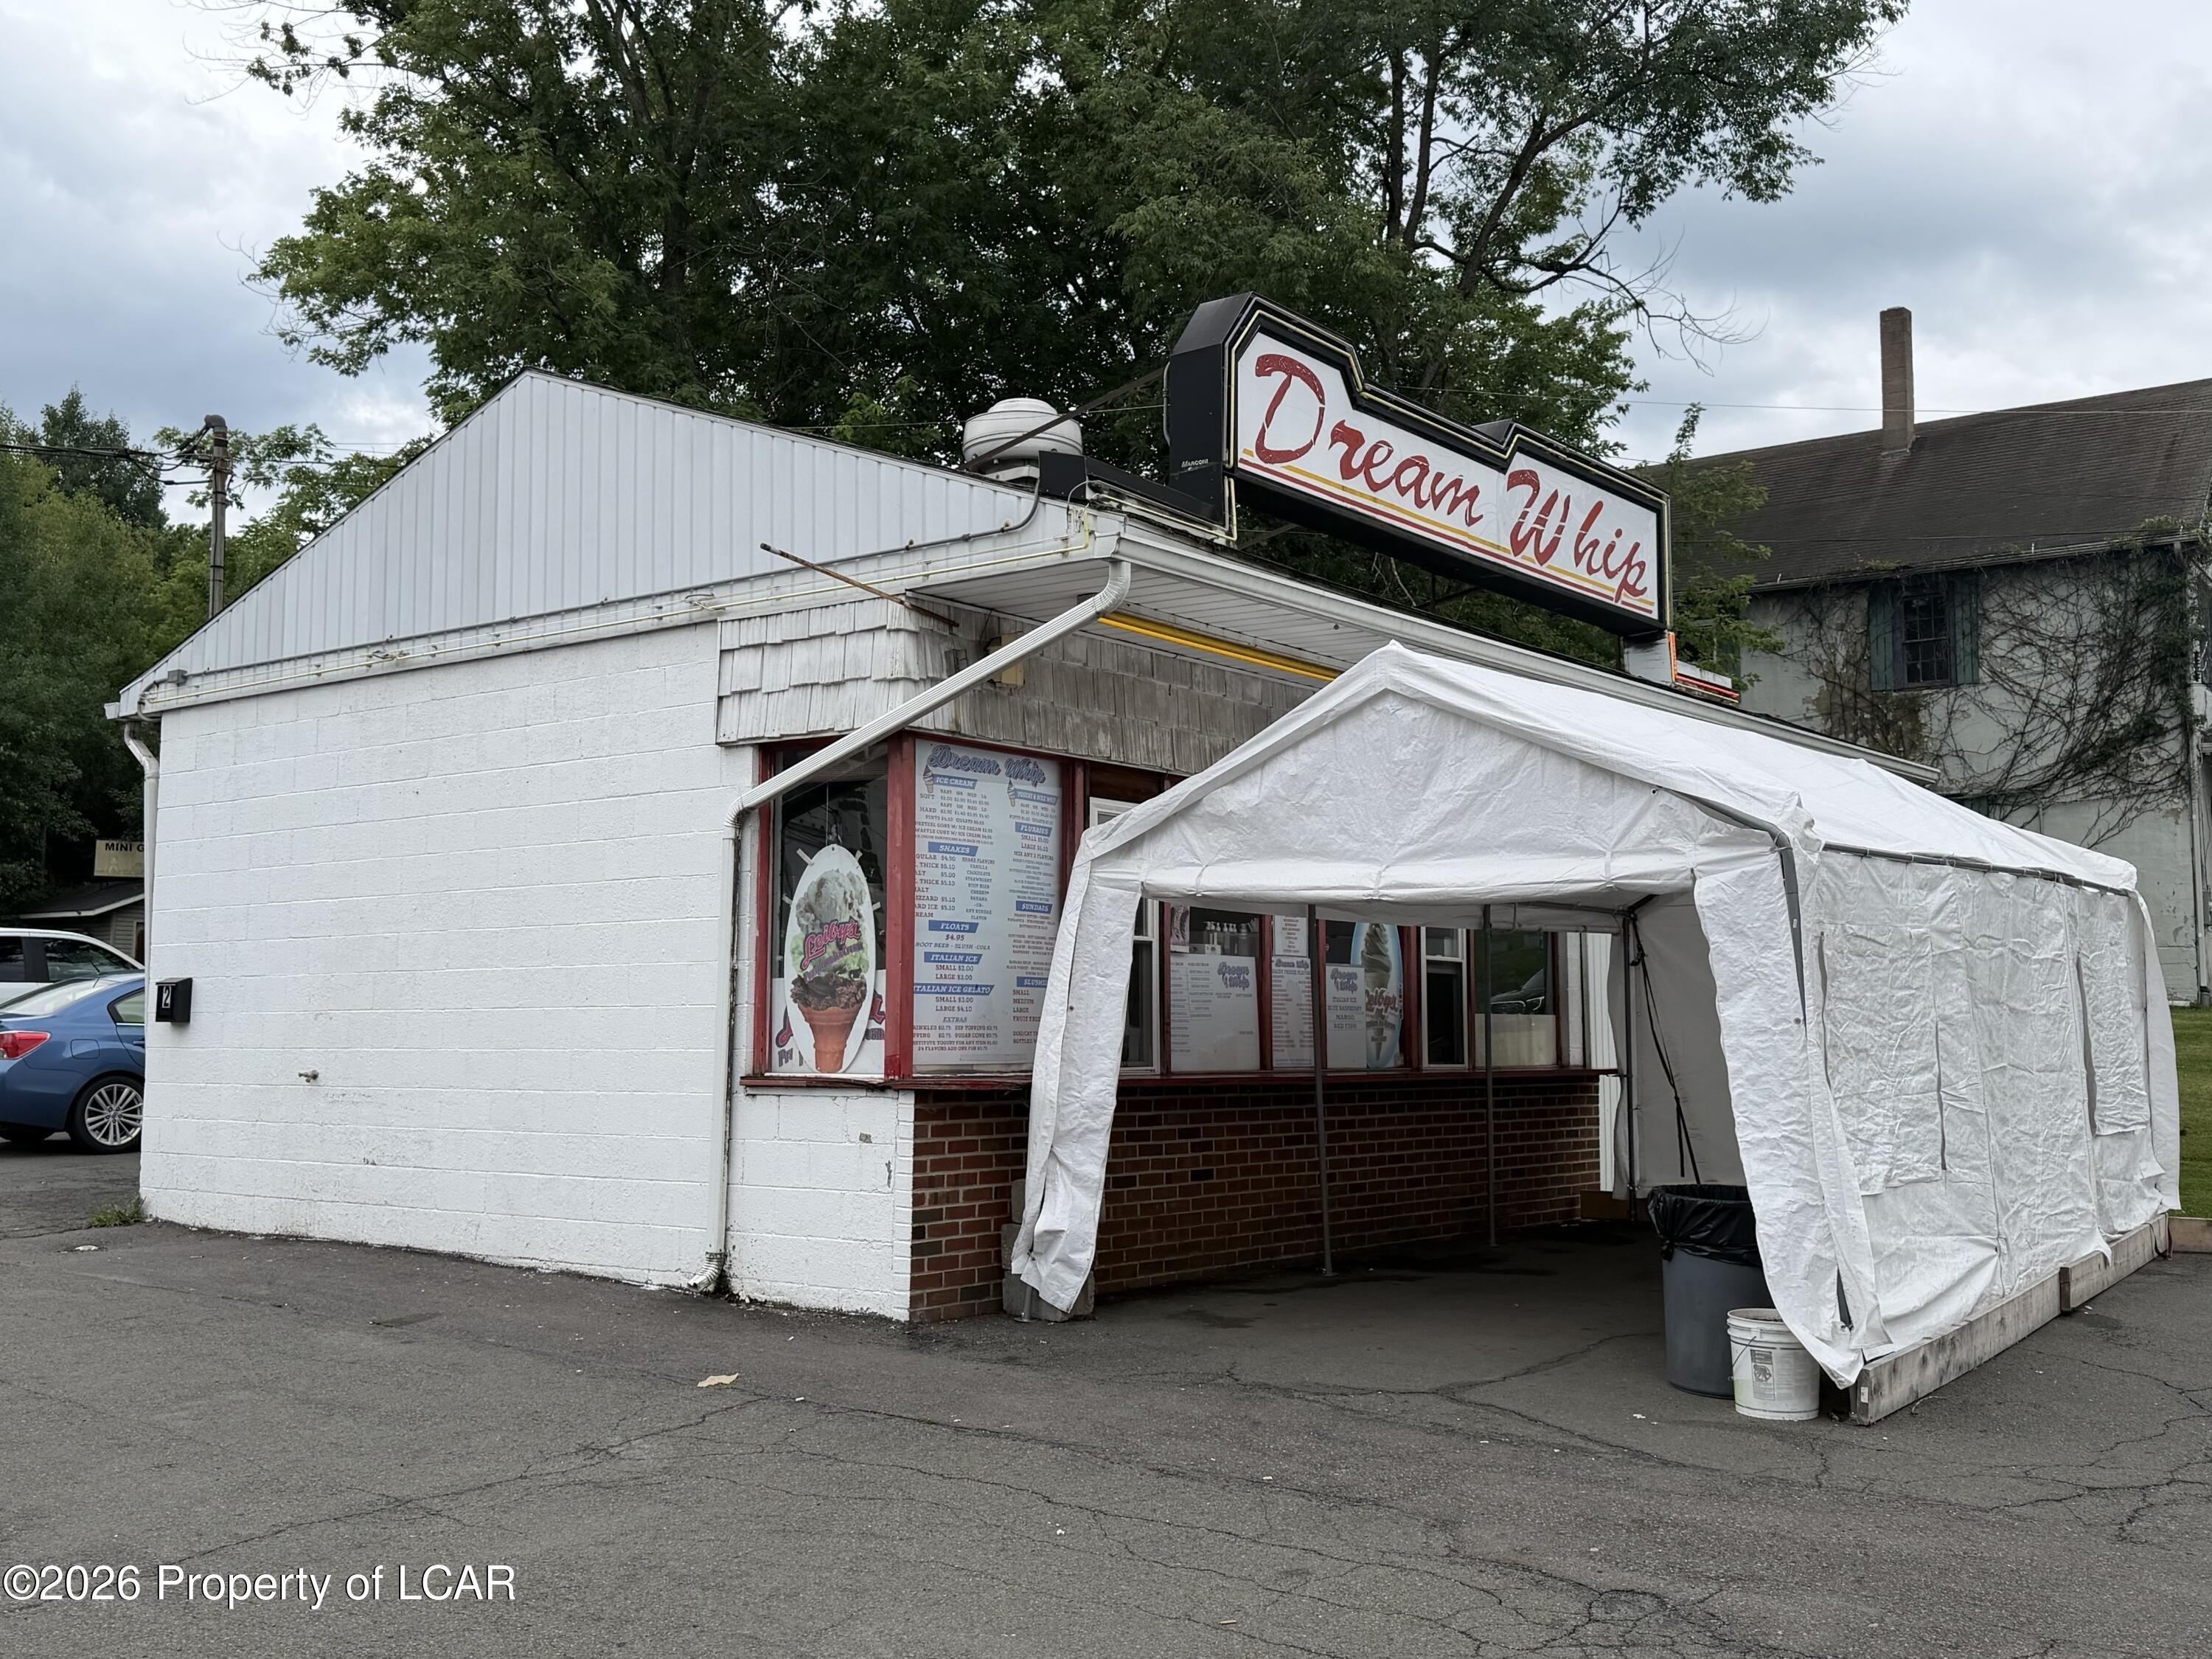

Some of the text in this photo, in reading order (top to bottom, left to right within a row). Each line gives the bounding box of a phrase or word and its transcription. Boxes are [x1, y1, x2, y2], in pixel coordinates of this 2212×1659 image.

[1255, 354, 1648, 602] Dream Whip
[927, 745, 1046, 787] Dream Whip
[950, 779, 974, 787] CREAM
[105, 843, 132, 852] MINI
[939, 845, 970, 854] SHAKES
[940, 922, 970, 931] FLOATS
[164, 986, 170, 1007] 2
